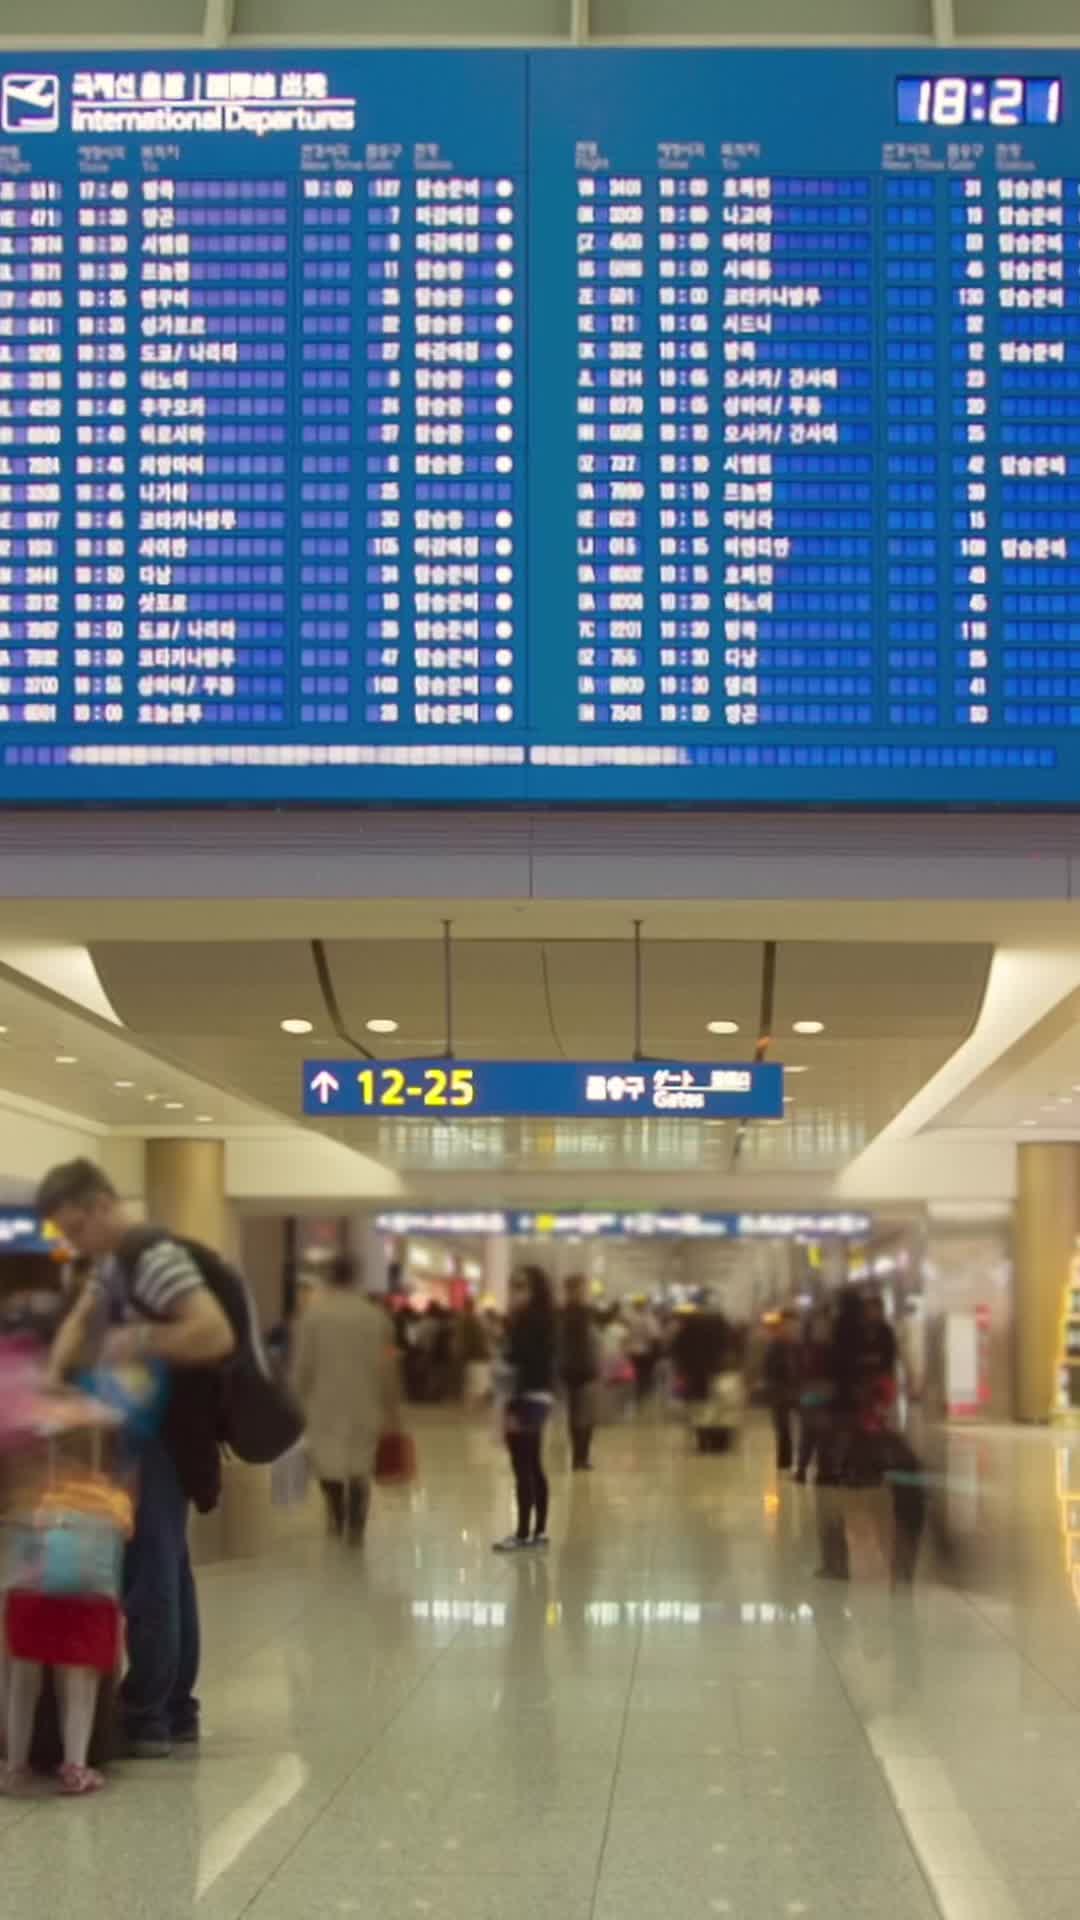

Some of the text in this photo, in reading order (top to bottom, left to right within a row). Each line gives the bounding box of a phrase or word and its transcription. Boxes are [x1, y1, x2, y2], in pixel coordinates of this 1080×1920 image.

[918, 78, 1059, 125] 18:21
[71, 107, 355, 136] International Departures
[358, 1069, 473, 1106] 12-25
